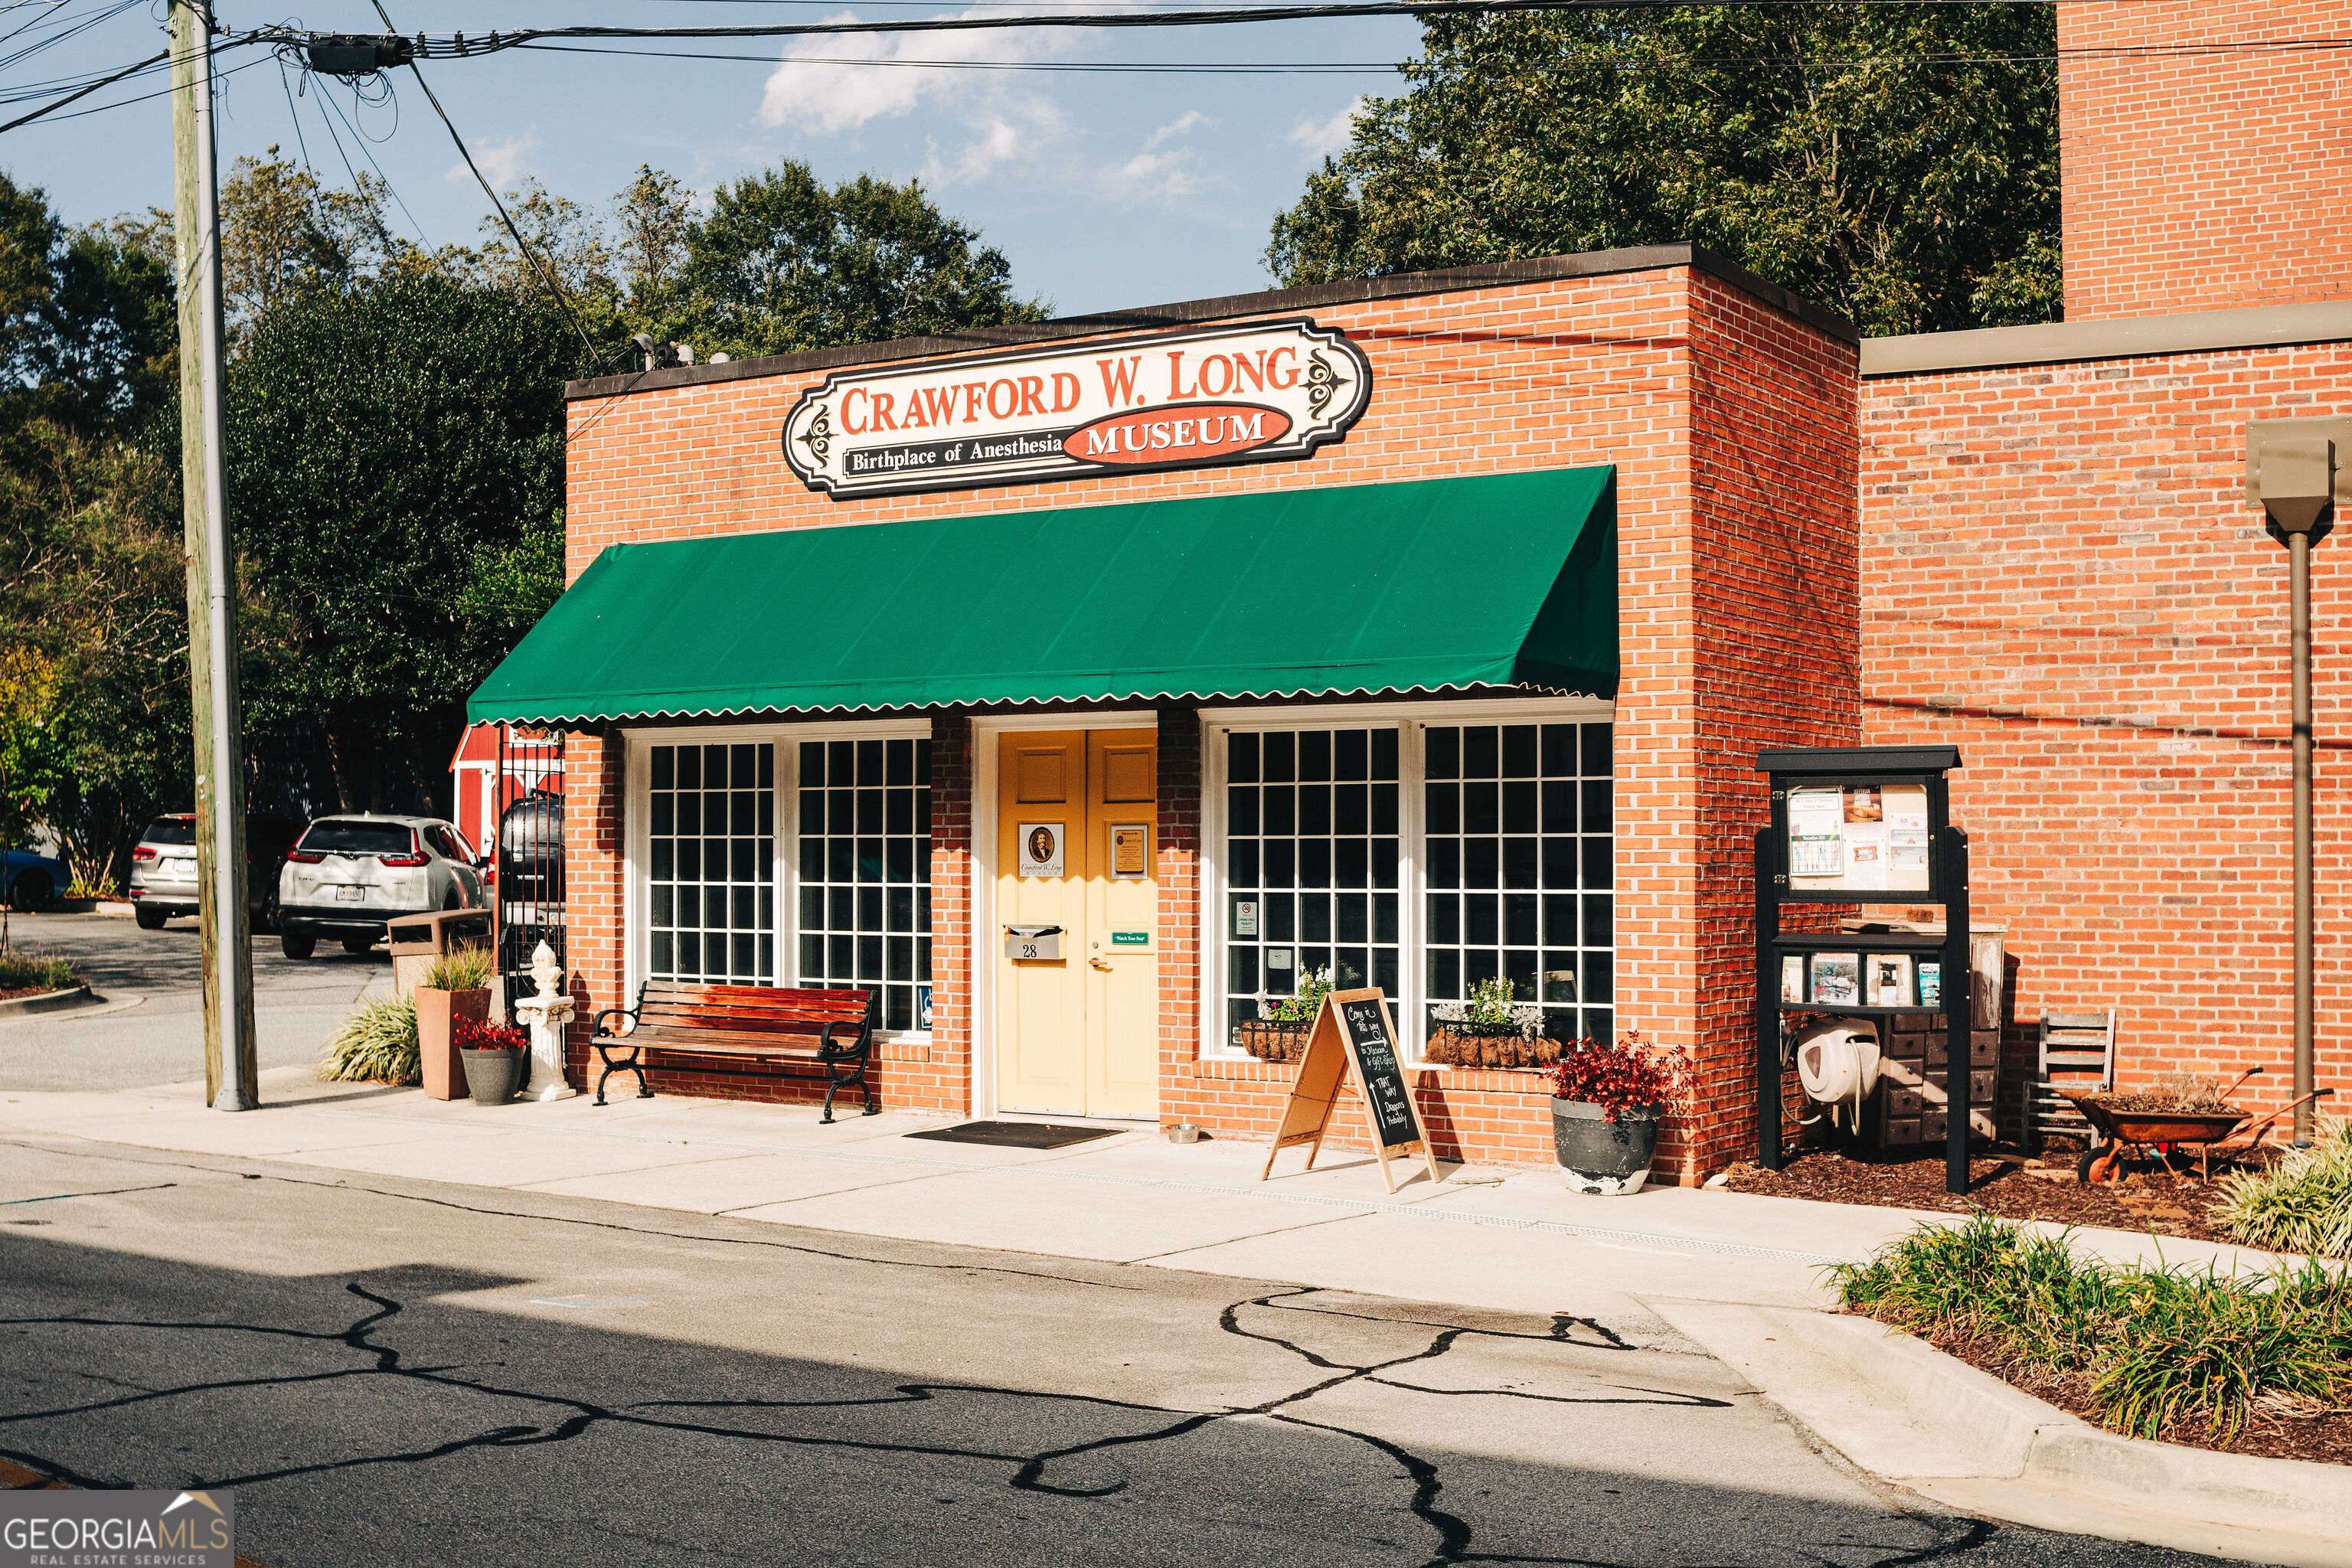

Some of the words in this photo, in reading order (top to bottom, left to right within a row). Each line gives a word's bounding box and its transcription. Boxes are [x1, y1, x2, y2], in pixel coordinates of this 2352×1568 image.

[841, 373, 1081, 435] CRAWFORD
[1096, 355, 1145, 408] W.
[1167, 346, 1302, 400] LONG
[1086, 412, 1266, 456] MUSEUM
[852, 447, 936, 471] Birthplace
[945, 443, 962, 461] of
[970, 433, 1063, 460] Anesthesia
[1022, 944, 1037, 958] 28
[1348, 1006, 1365, 1021] Come
[1361, 1047, 1367, 1055] to
[1376, 1076, 1390, 1089] THAT
[1384, 1086, 1396, 1098] WAY
[1384, 1101, 1405, 1116] Dragons
[1387, 1112, 1408, 1130] Probably
